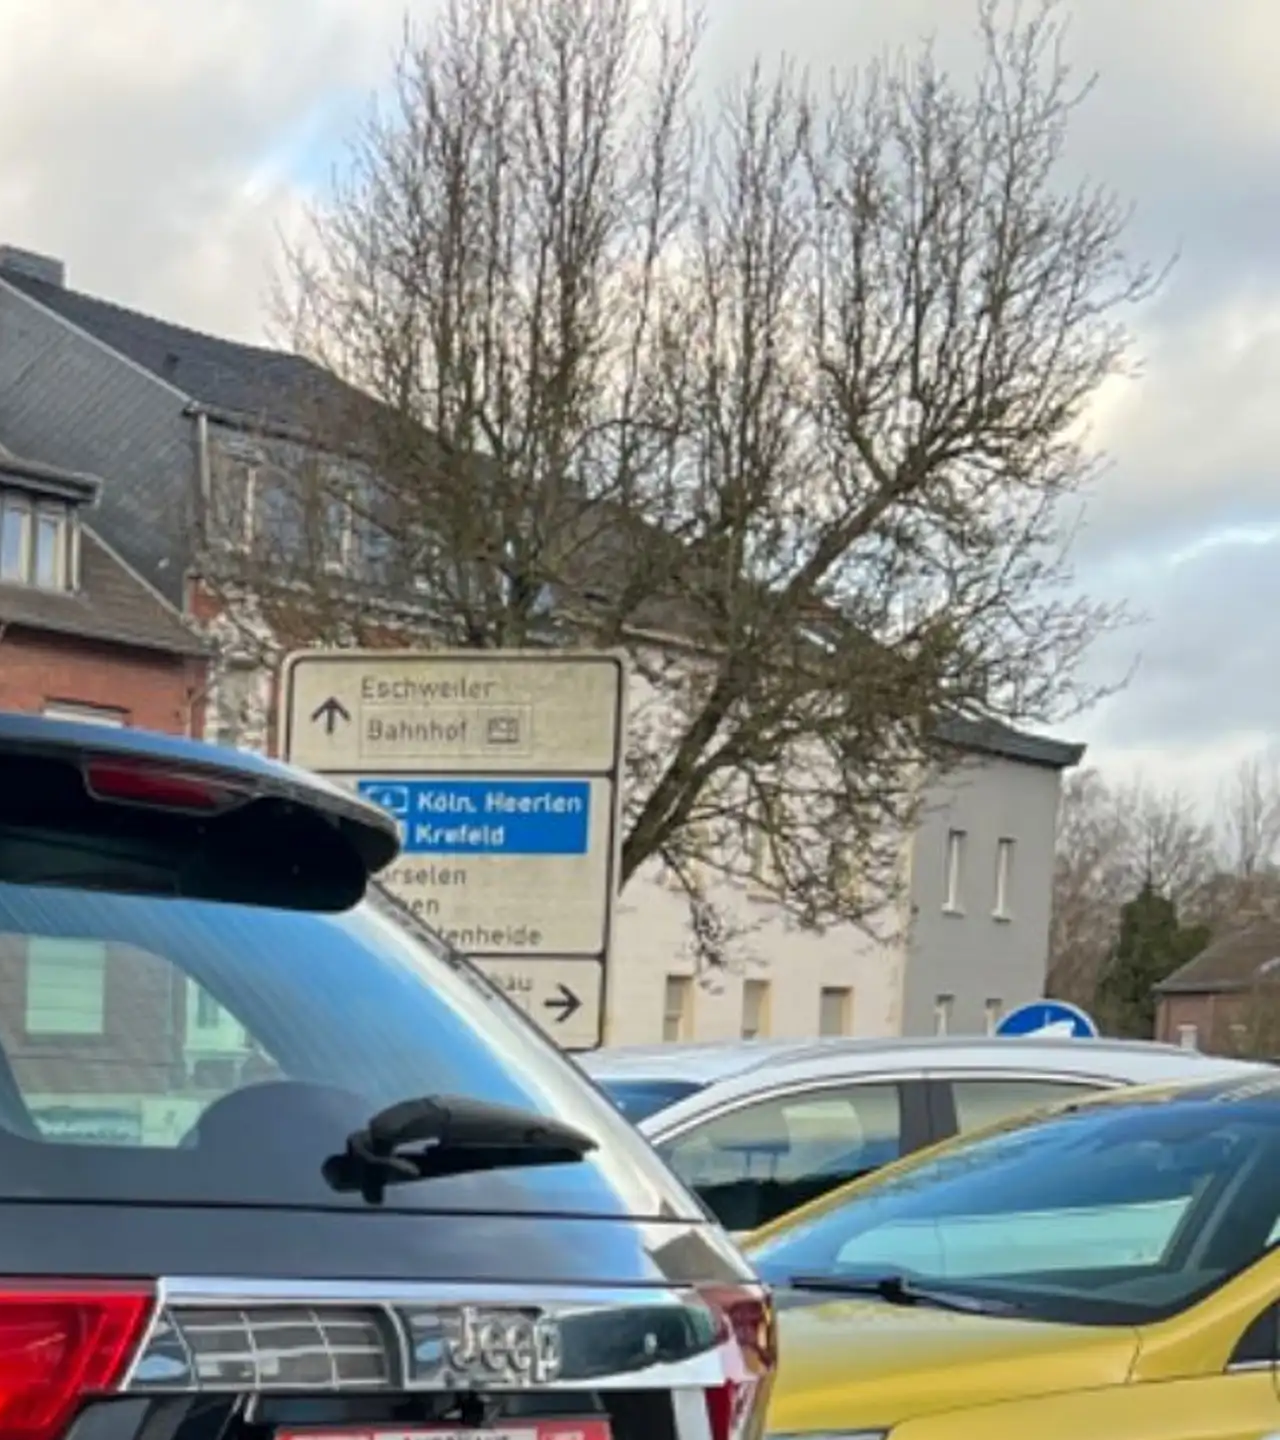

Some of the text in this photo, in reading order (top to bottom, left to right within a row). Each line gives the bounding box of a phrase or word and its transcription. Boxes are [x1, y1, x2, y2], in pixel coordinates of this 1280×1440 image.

[360, 675, 497, 699] Eschweiler
[366, 718, 467, 743] Bahnhof
[484, 792, 582, 814] Heerlen
[414, 823, 506, 847] Krefeld
[382, 864, 467, 886] rselen
[450, 1304, 563, 1382] Jeep
